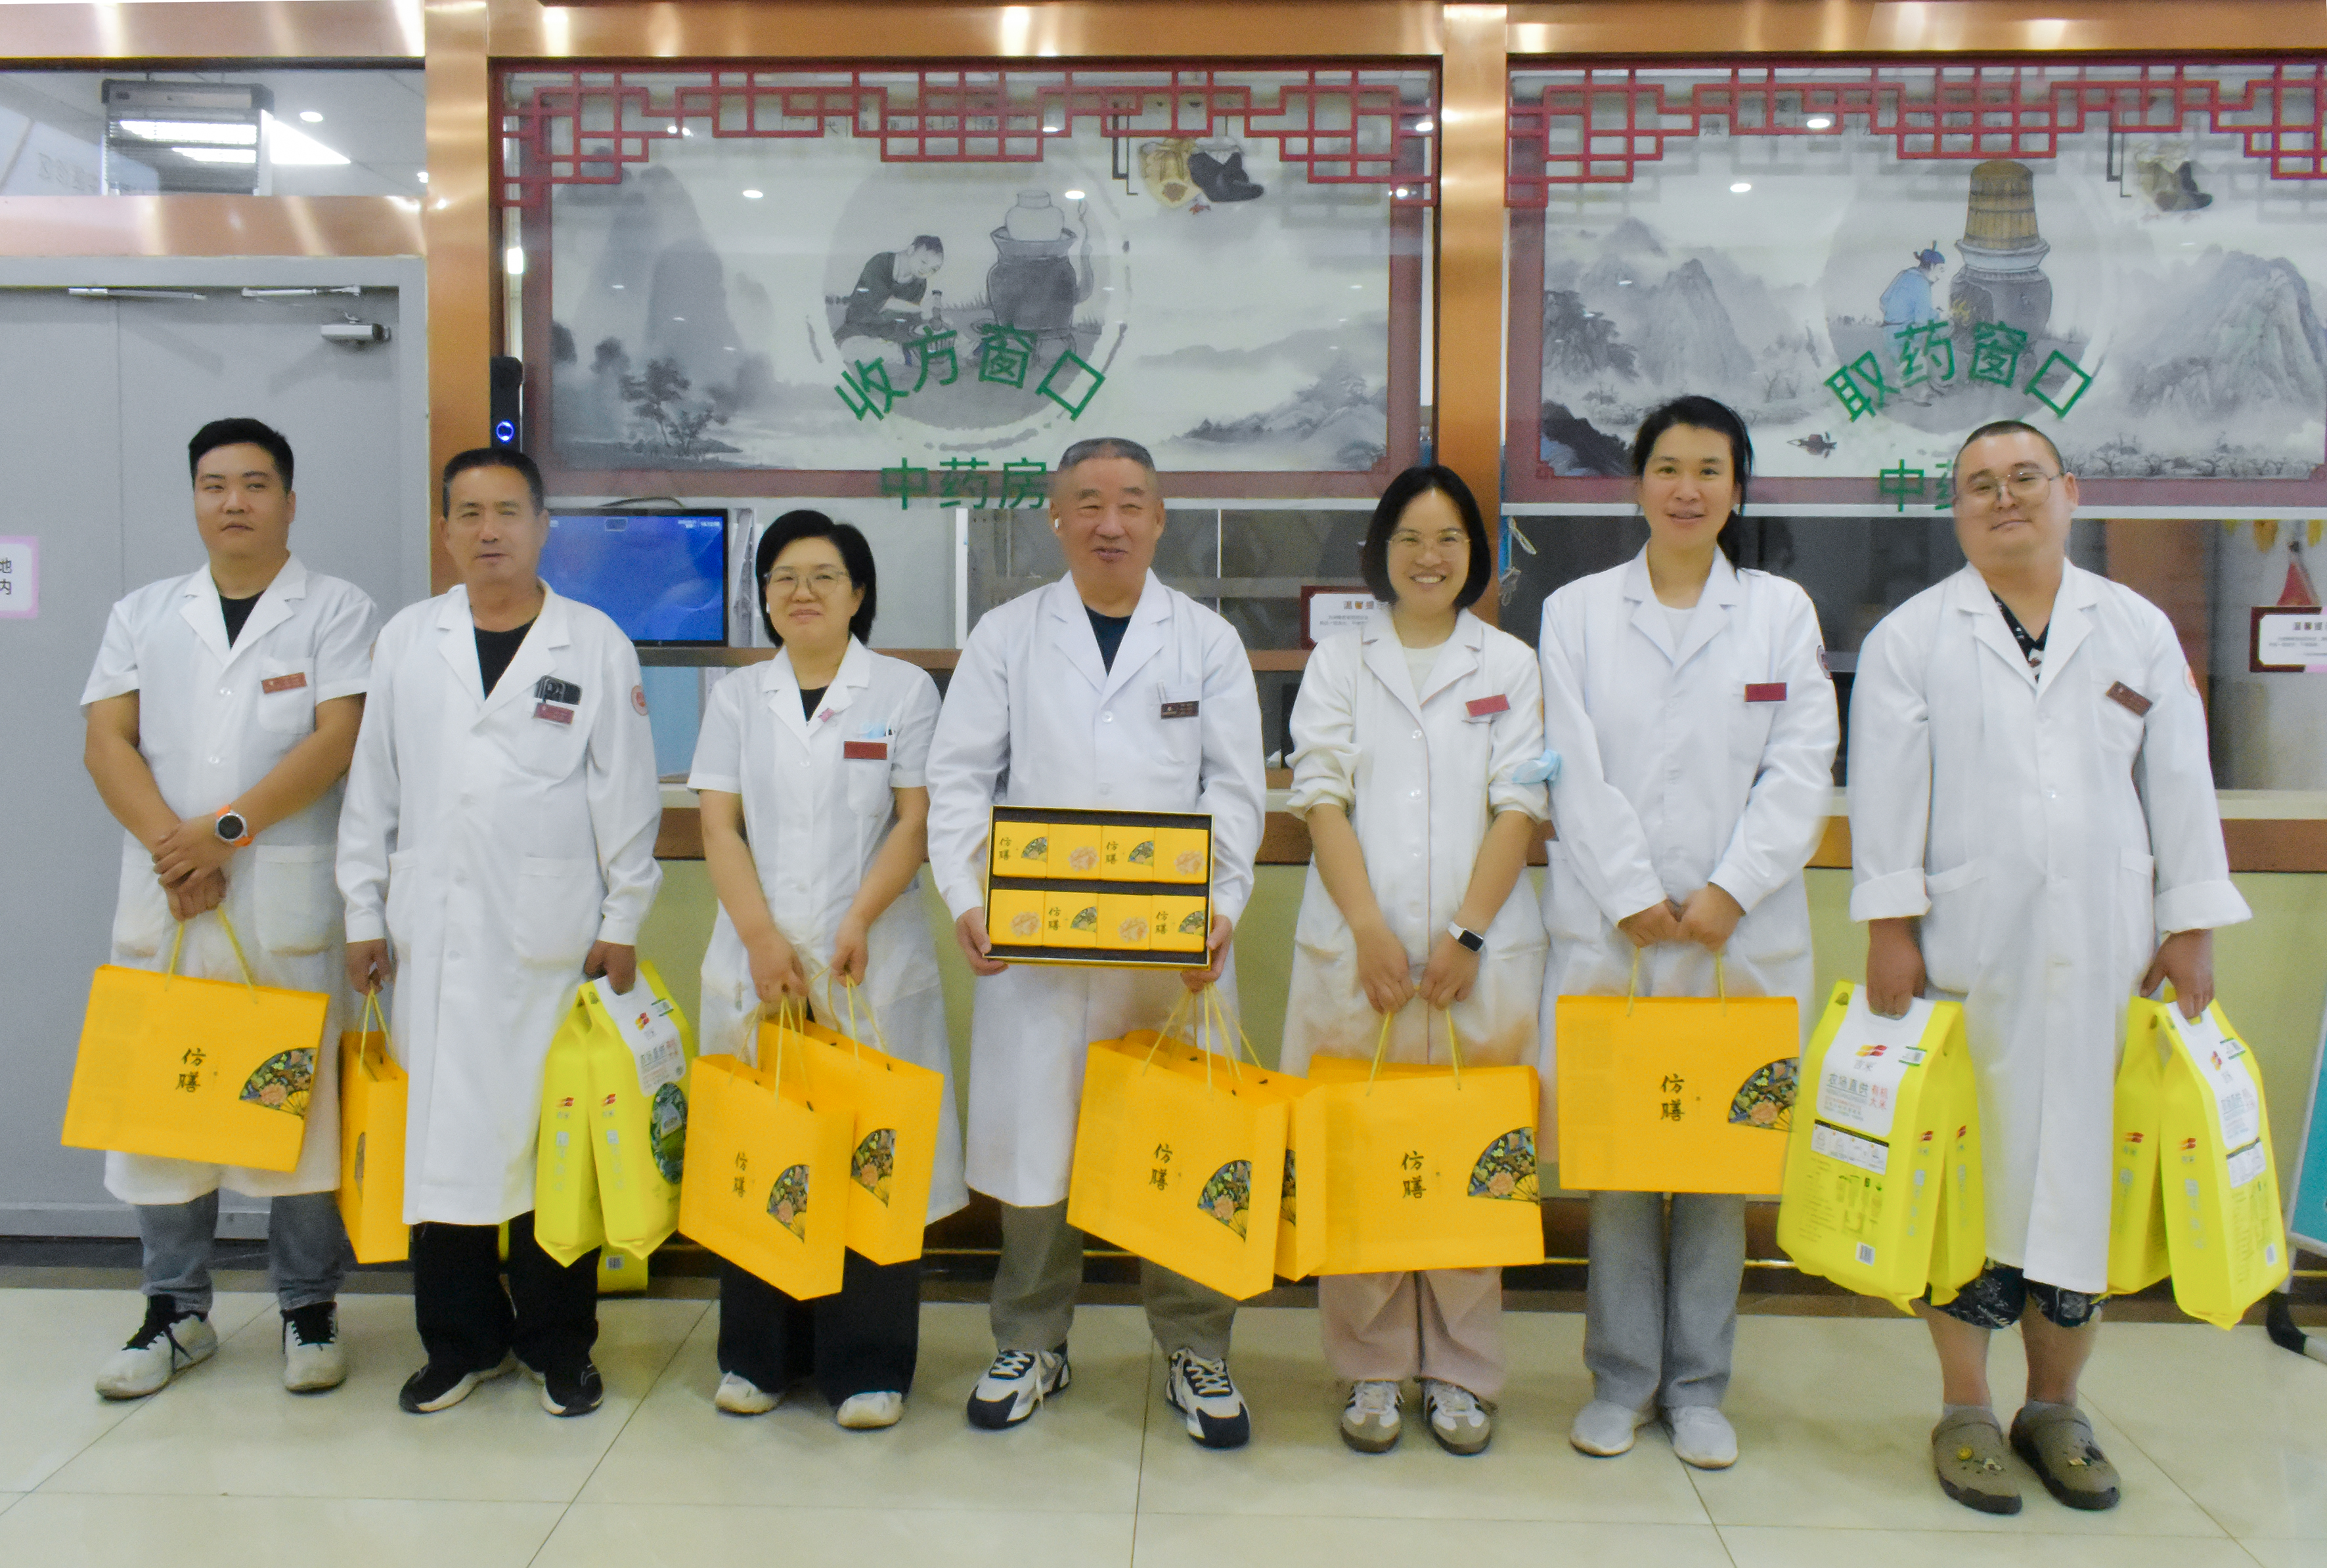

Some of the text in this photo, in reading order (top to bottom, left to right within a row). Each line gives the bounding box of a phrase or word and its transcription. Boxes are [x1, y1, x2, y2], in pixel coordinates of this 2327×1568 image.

[834, 324, 1105, 422] 收方窗口
[1823, 319, 2092, 422] 取药窗口
[881, 457, 1048, 510] 中药房
[176, 1048, 207, 1093] 仿膳
[1660, 1073, 1685, 1122] 仿膳
[1149, 1143, 1174, 1191] 仿膳
[1400, 1150, 1427, 1199] 仿膳
